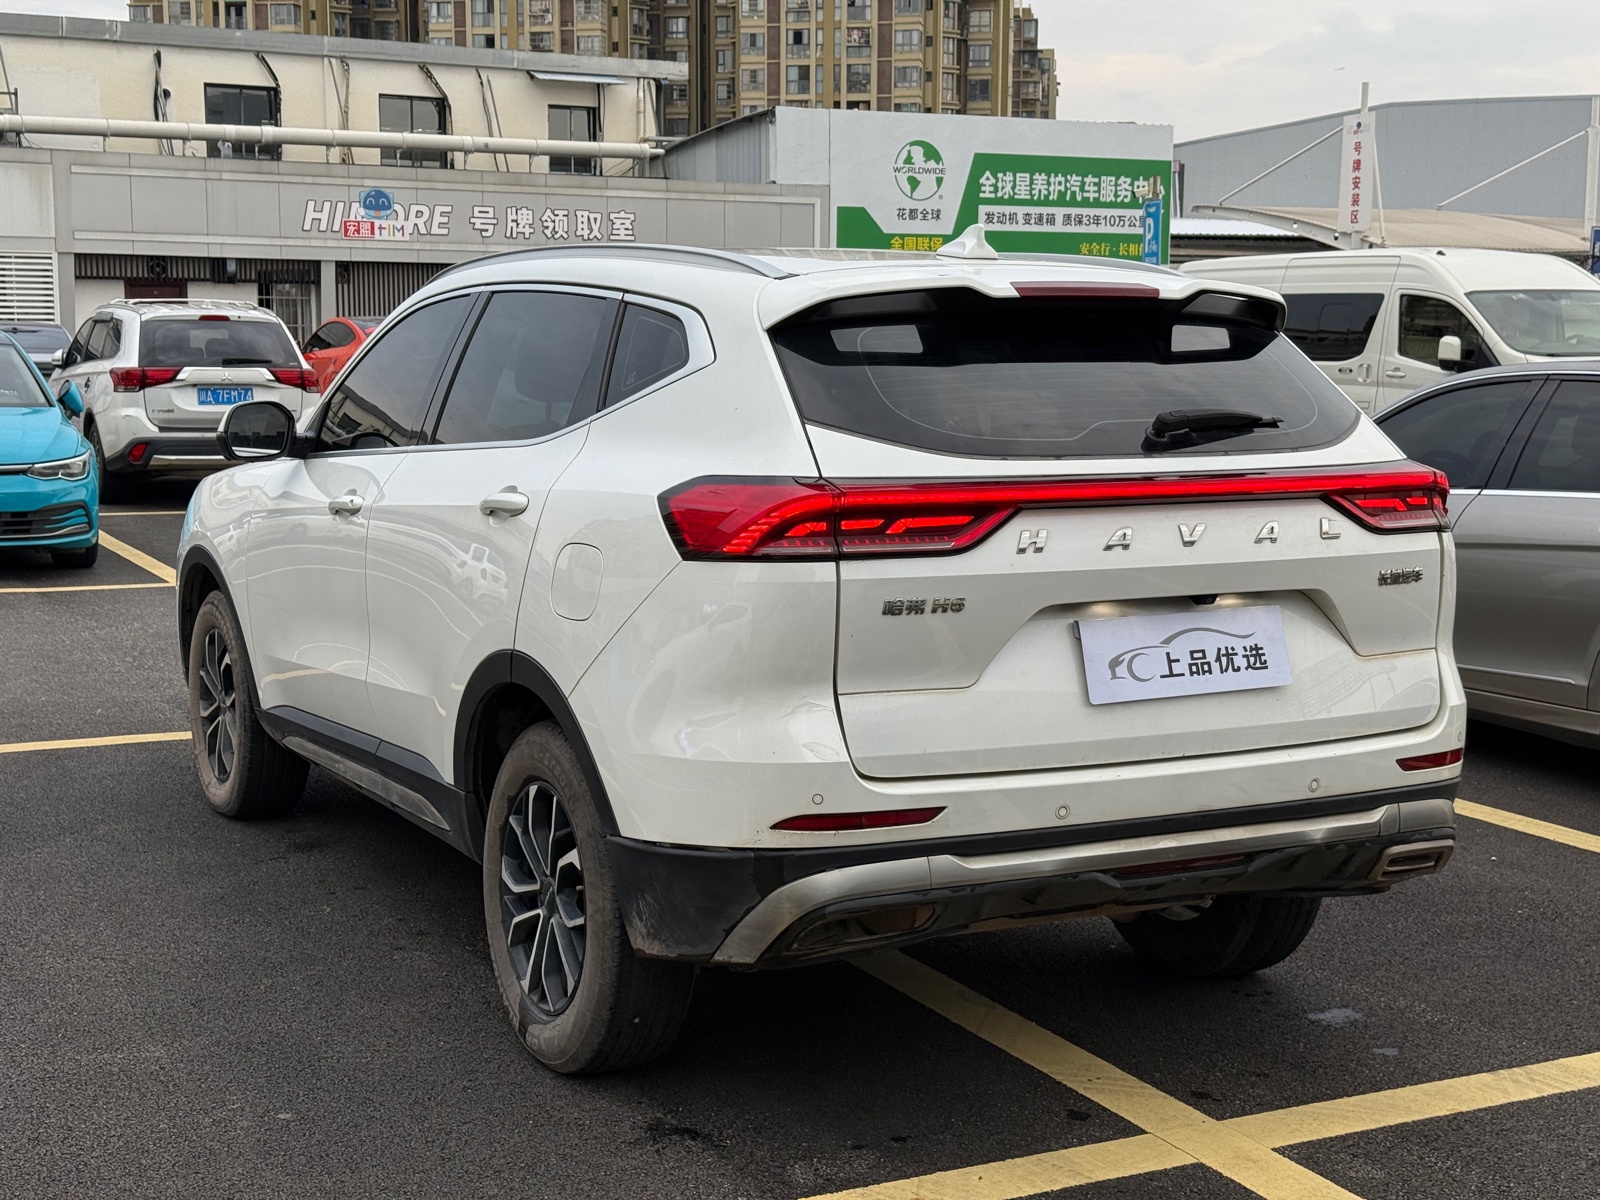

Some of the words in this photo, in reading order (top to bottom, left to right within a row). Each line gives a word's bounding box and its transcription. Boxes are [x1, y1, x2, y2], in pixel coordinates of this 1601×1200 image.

[893, 166, 946, 175] WORLDWIDE
[1350, 141, 1362, 224] 号牌安装区
[896, 207, 942, 221] 花都全球
[984, 211, 1019, 226] 发动机
[1022, 213, 1056, 227] 变速箱
[346, 222, 371, 237] 宏盟
[469, 205, 636, 241] 号牌领取室
[890, 236, 943, 251] 全国联保
[930, 595, 966, 614] H6
[1159, 643, 1269, 680] 上品优选
